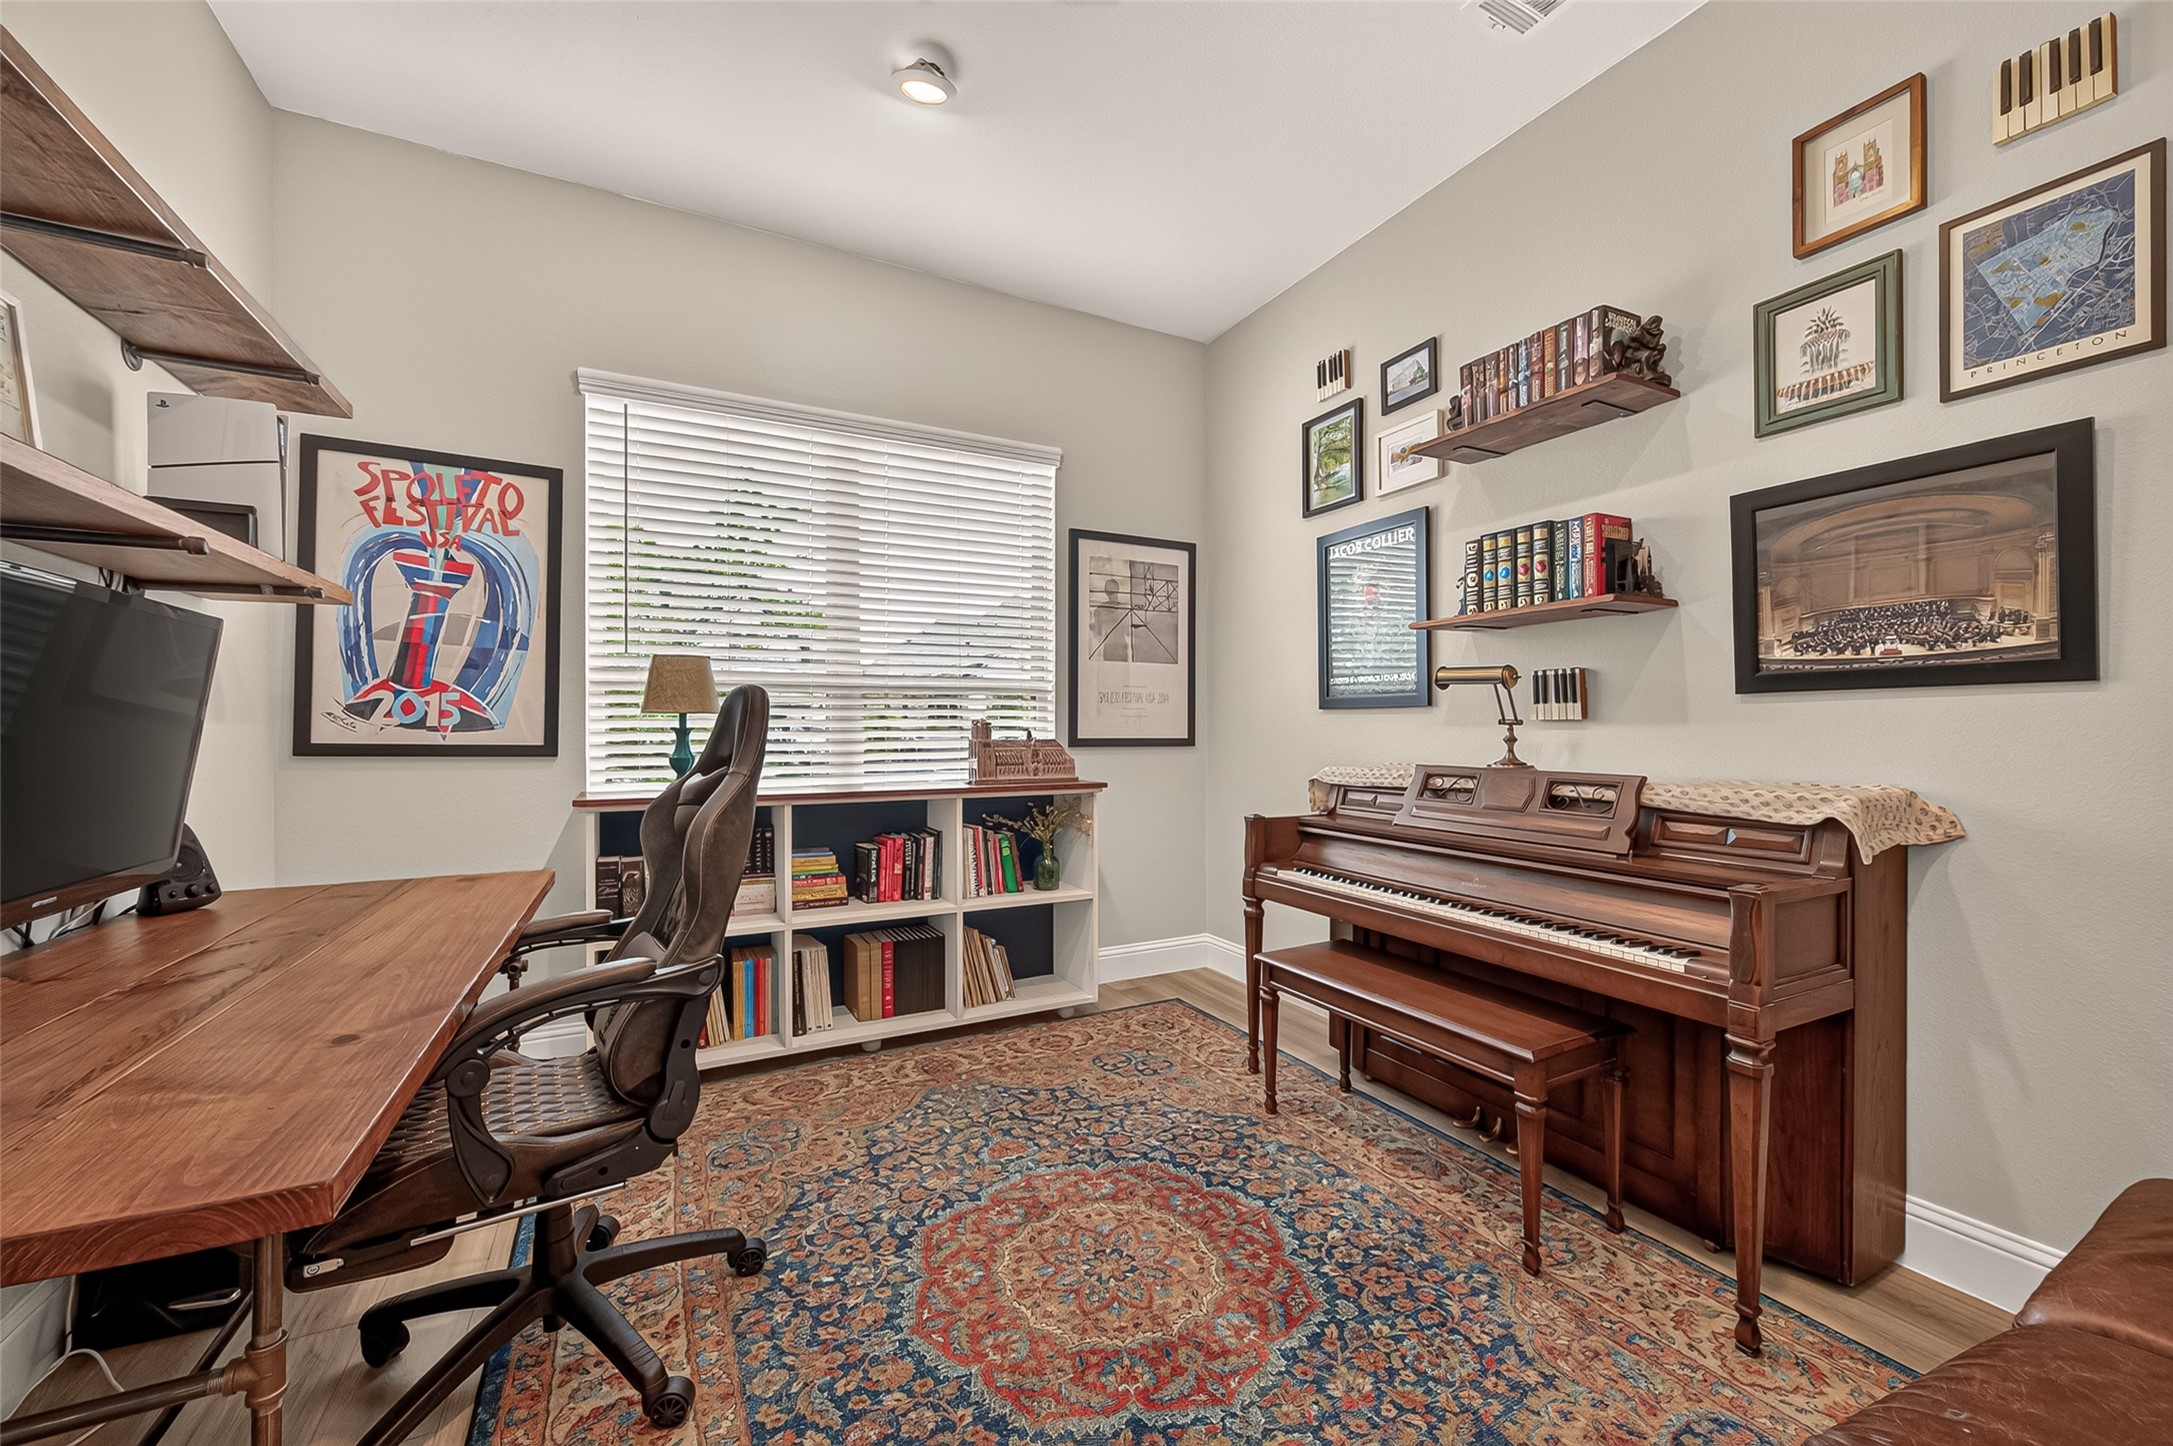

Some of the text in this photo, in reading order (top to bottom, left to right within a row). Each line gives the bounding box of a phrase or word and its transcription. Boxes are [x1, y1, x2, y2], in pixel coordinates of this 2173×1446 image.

[1970, 330, 2127, 378] PRINCETON
[354, 461, 524, 520] SPOLETO
[360, 495, 520, 536] FESTIVAL
[420, 530, 462, 552] USA
[1364, 527, 1416, 550] COLLIER
[362, 689, 461, 727] 2015
